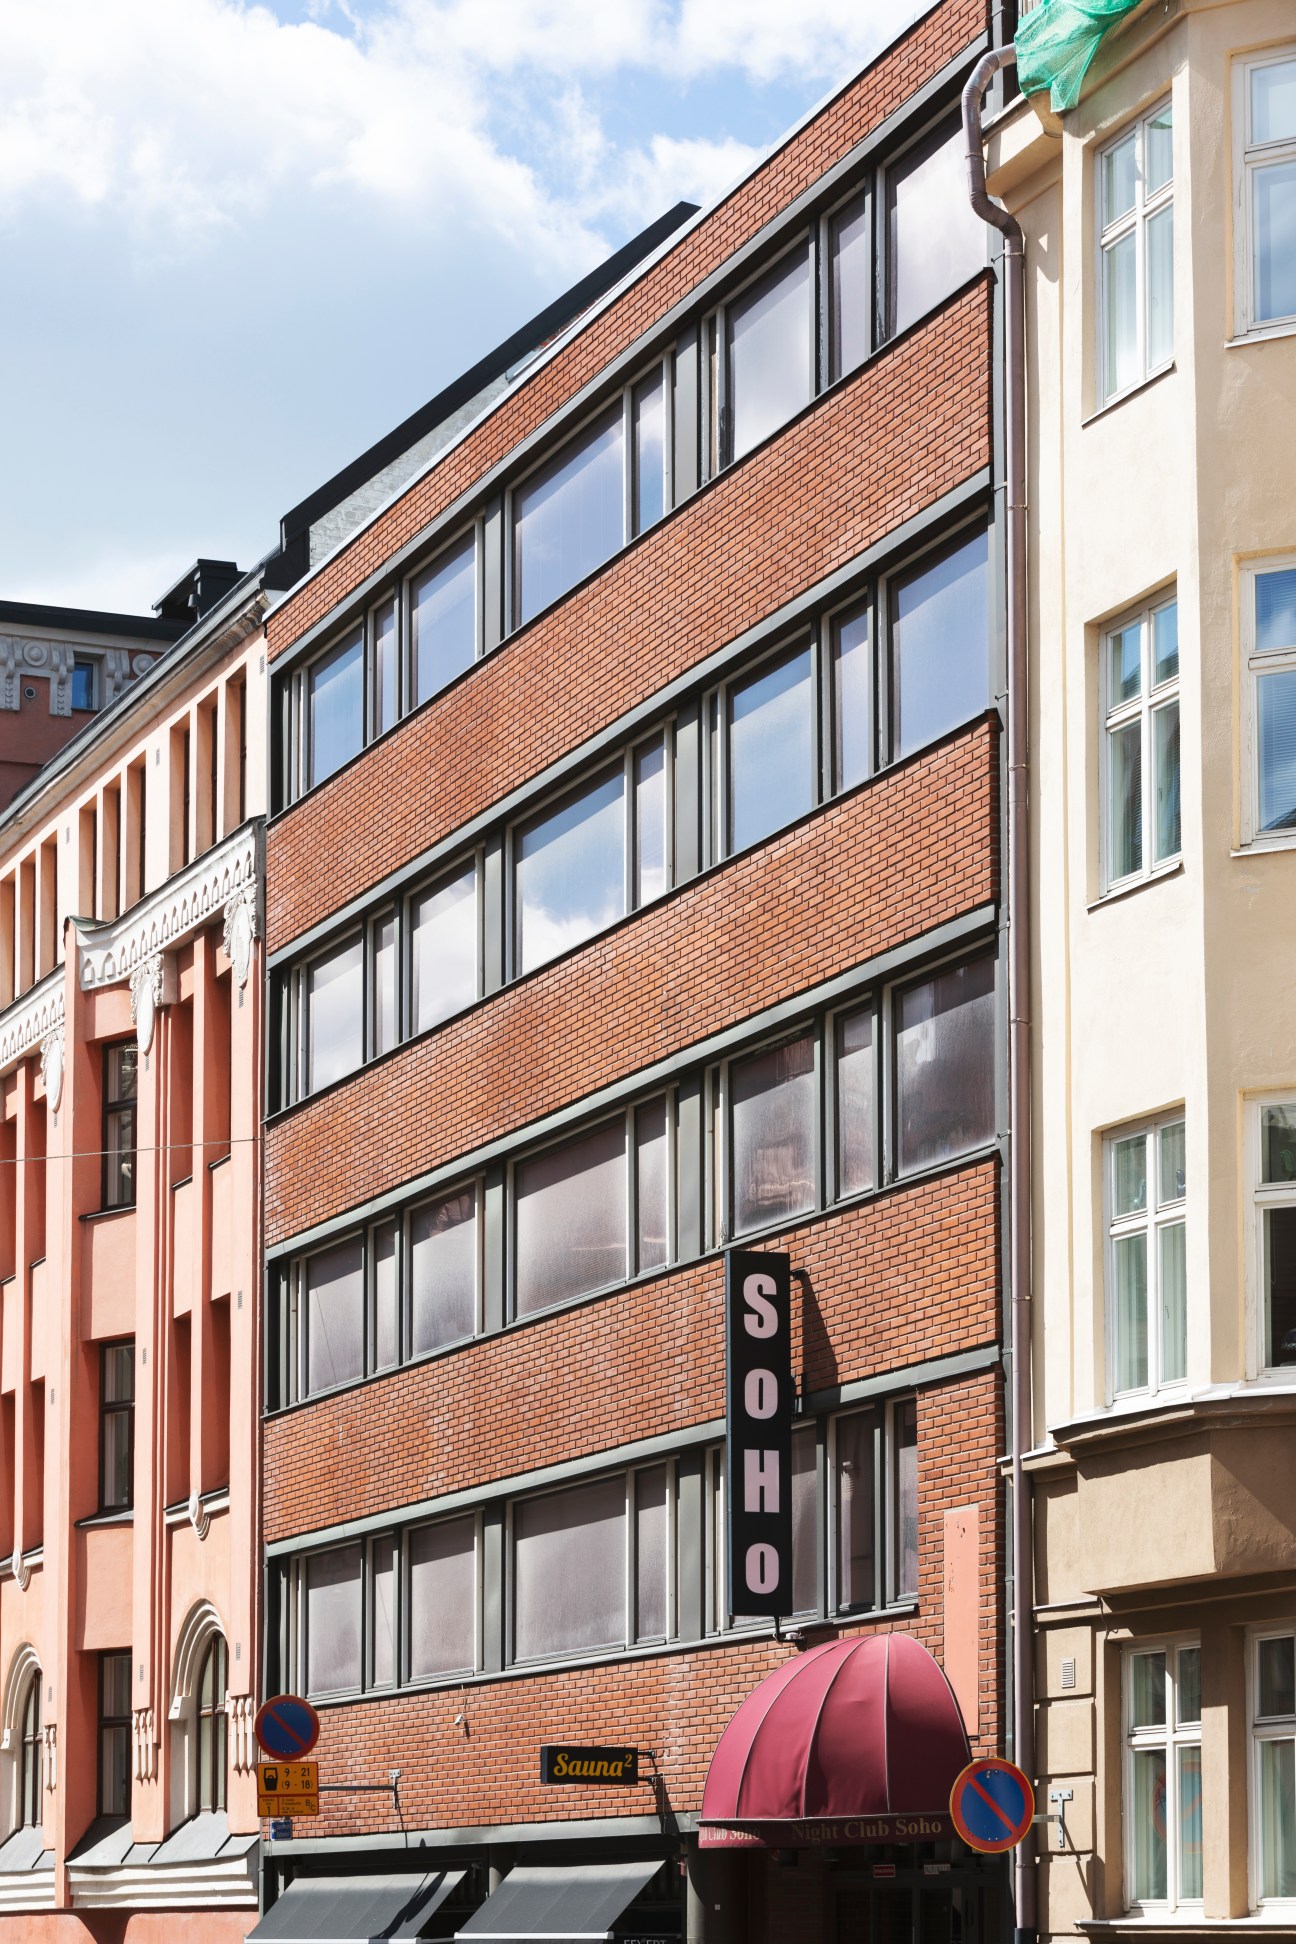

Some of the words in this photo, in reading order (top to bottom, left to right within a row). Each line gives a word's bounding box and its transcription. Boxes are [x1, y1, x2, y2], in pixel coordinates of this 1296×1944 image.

[743, 1273, 780, 1595] SOHO
[284, 1767, 290, 1777] 9
[301, 1767, 310, 1777] 21
[266, 1806, 271, 1815] 1
[792, 1823, 839, 1844] Night
[844, 1821, 890, 1838] Club
[896, 1817, 942, 1835] Soho
